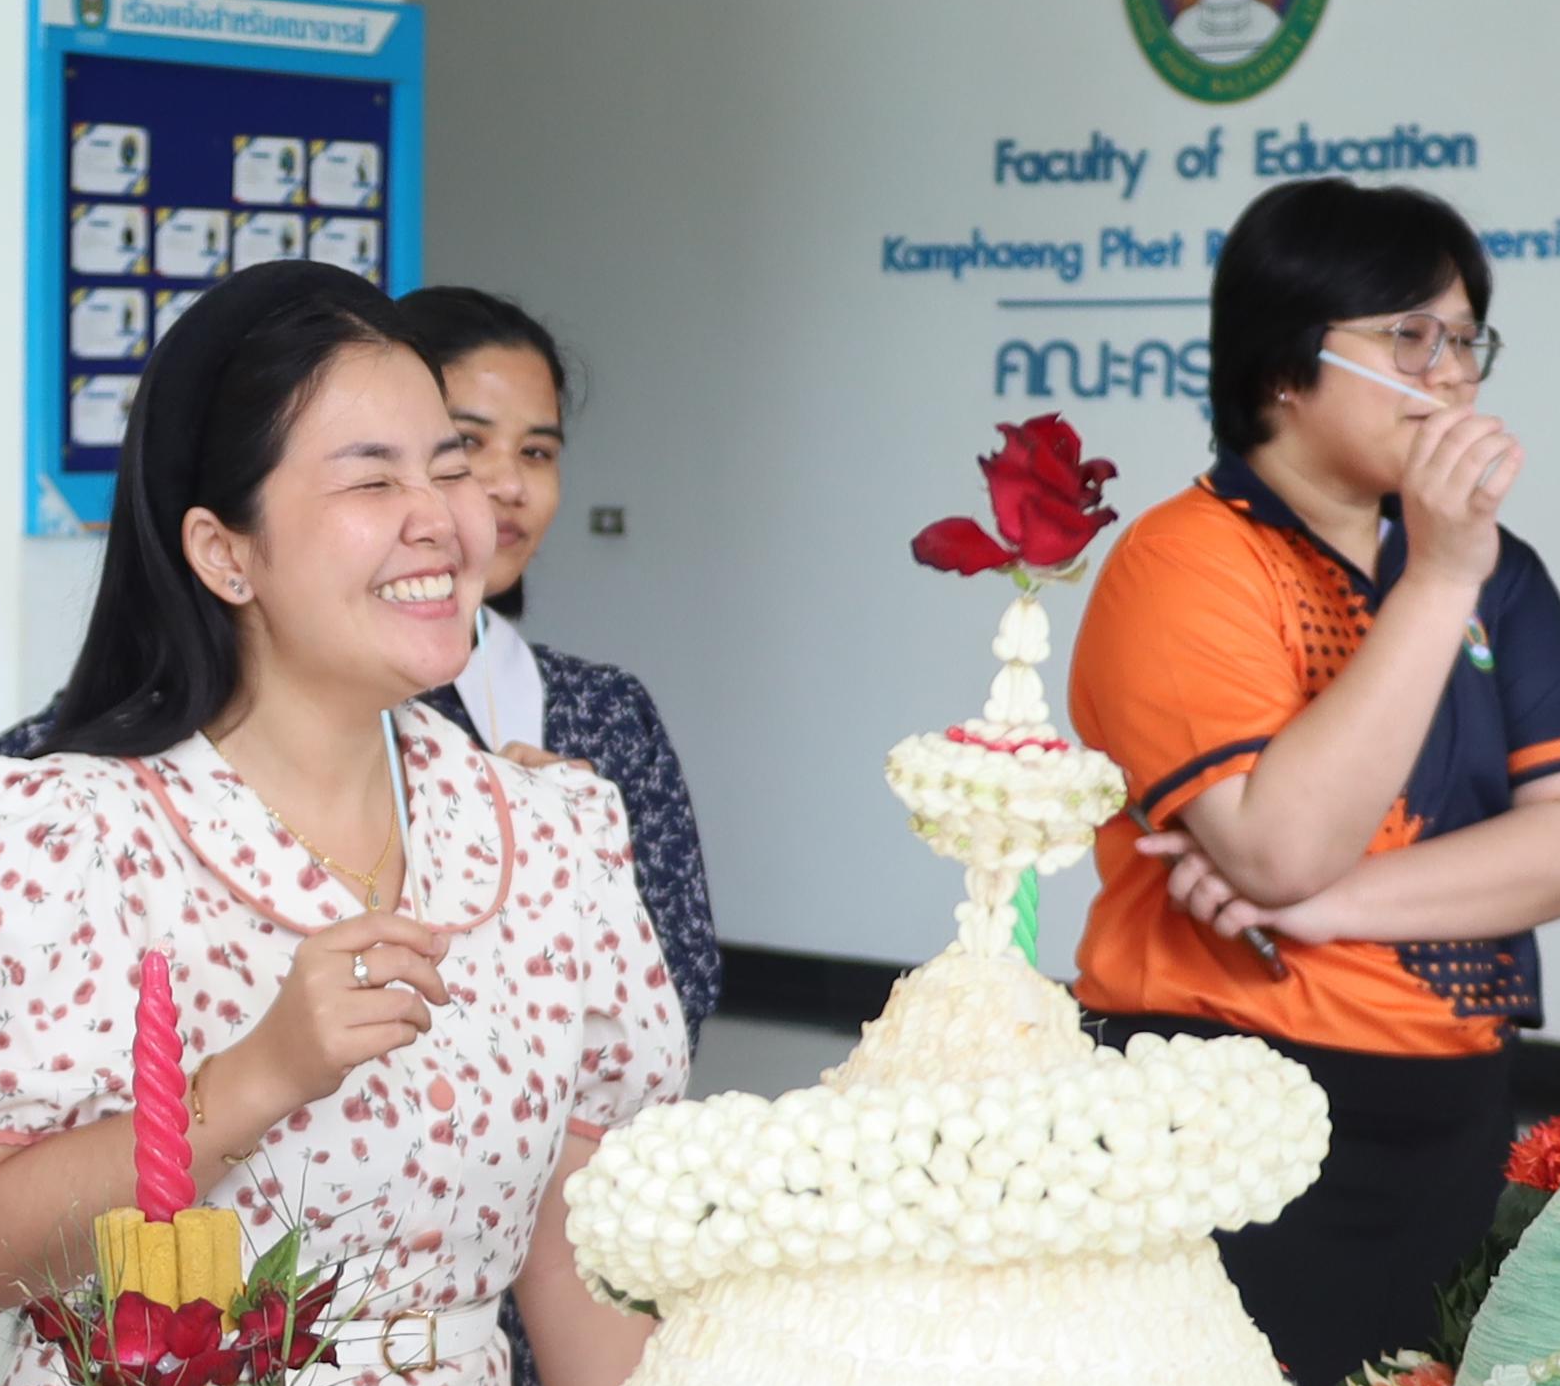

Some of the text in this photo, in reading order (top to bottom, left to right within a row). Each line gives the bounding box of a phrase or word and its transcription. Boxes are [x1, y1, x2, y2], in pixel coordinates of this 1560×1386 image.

[994, 121, 1478, 200] Faculty of Education
[882, 226, 1084, 283] Kamphaeng
[1100, 224, 1184, 268] Phet
